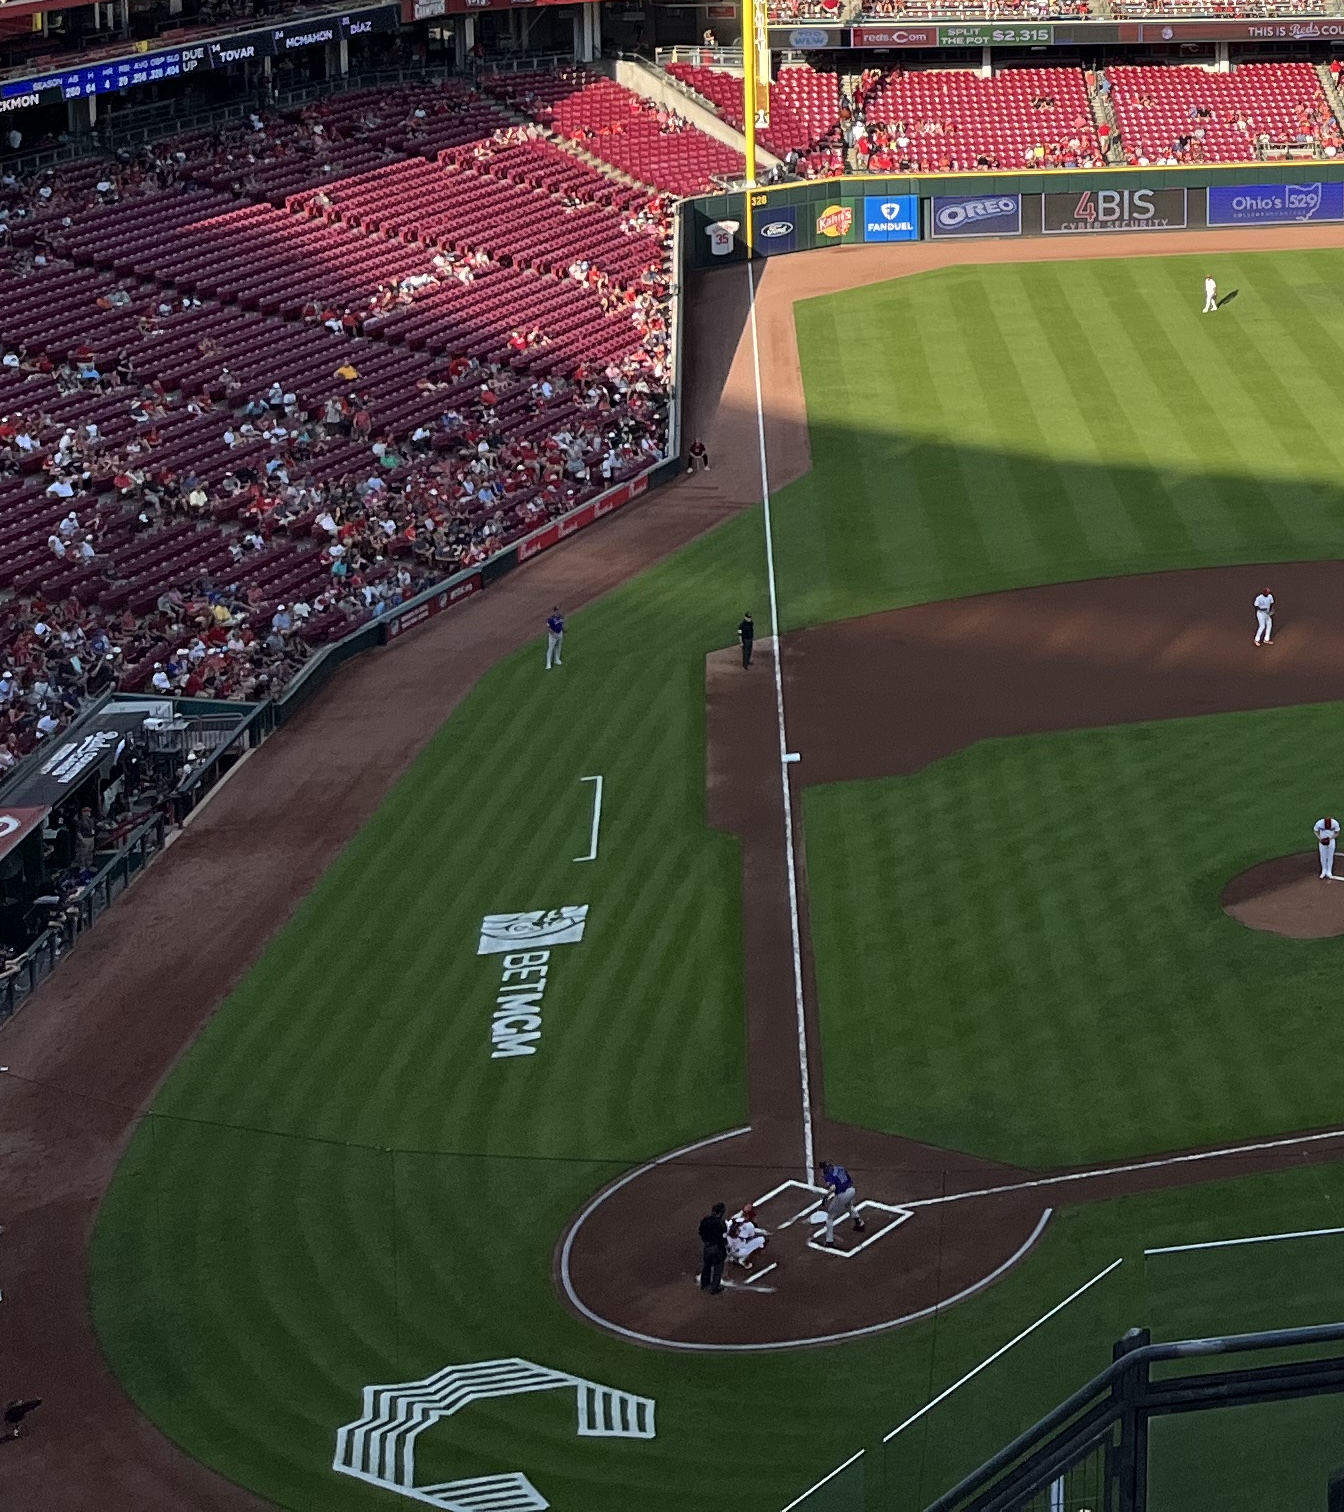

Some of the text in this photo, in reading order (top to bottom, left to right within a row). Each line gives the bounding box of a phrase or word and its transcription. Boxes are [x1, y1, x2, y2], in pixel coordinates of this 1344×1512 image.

[350, 21, 372, 35] DÍAZ
[948, 28, 980, 36] SPLIT
[992, 29, 1049, 42] $2,315
[1248, 27, 1272, 37] THIS
[1275, 27, 1286, 37] IS
[1290, 22, 1321, 39] Reds
[286, 29, 333, 49] MCMAHON
[940, 36, 990, 44] THE POT
[182, 47, 204, 61] DUE
[220, 45, 255, 63] TOVAR
[182, 60, 198, 74] UP
[1232, 193, 1318, 210] Ohio's 529
[939, 199, 1014, 225] OREO
[818, 209, 852, 231] Kahn's
[868, 222, 913, 232] FANDUEL
[491, 950, 551, 1059] BETMGM
